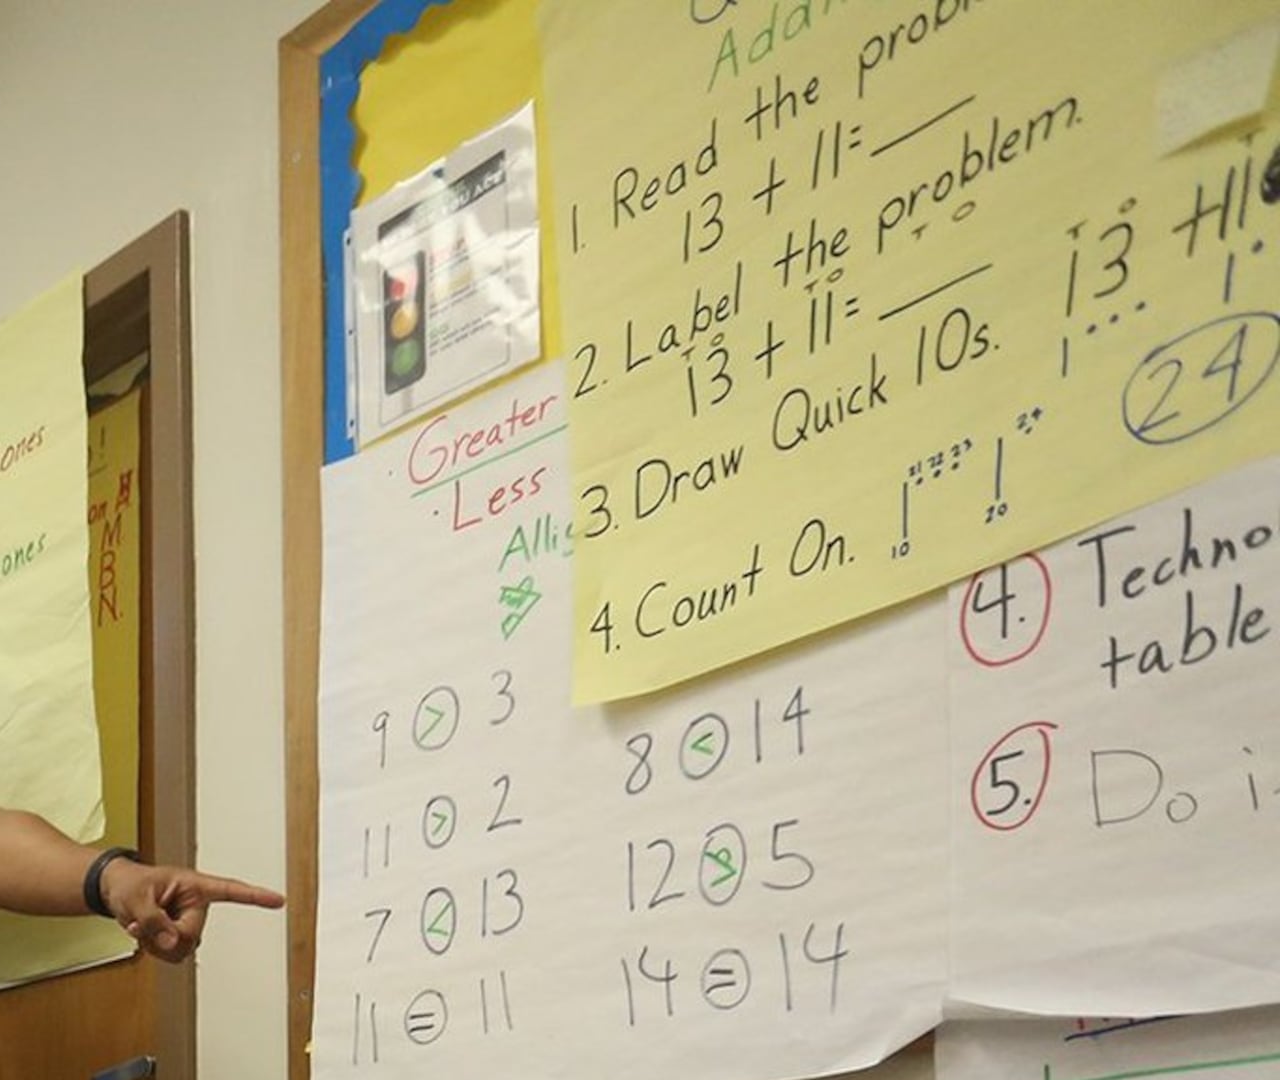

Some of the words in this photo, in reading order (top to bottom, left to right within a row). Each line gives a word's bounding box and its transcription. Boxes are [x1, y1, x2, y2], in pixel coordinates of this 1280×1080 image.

[571, 204, 588, 255] 1.
[612, 118, 720, 230] Read
[745, 74, 820, 141] the
[858, 0, 981, 98] prob
[574, 345, 610, 399] 2.
[626, 260, 743, 375] Label
[774, 219, 849, 287] the
[877, 97, 1084, 253] problem.
[682, 191, 725, 262] 13
[752, 158, 786, 216] +
[1065, 221, 1133, 318] 13
[687, 348, 733, 417] 13
[754, 321, 790, 378] +
[1135, 322, 1248, 436] 24
[407, 393, 558, 486] Greater
[580, 486, 620, 539] 3.
[635, 444, 745, 520] Draw
[771, 354, 888, 453] Quick
[916, 307, 1001, 387] 10s.
[452, 462, 548, 532] Less
[0, 532, 48, 579] ones
[589, 600, 622, 654] 4.
[635, 544, 764, 640] Count
[788, 518, 856, 577] On.
[972, 563, 1026, 638] 4.
[1100, 583, 1272, 689] table
[371, 710, 390, 768] 9
[489, 669, 516, 726] 3
[623, 732, 653, 795] 8
[753, 685, 811, 763] 14
[363, 823, 392, 878] 11
[486, 774, 523, 832] 2
[986, 749, 1032, 816] 5.
[1091, 748, 1198, 828] Do
[626, 839, 685, 911] 12
[761, 818, 814, 890] 5
[363, 908, 393, 963] 7
[479, 868, 524, 937] 13
[351, 993, 379, 1066] 11
[479, 970, 513, 1034] 11
[620, 946, 679, 1026] 14
[777, 921, 849, 1015] 14
